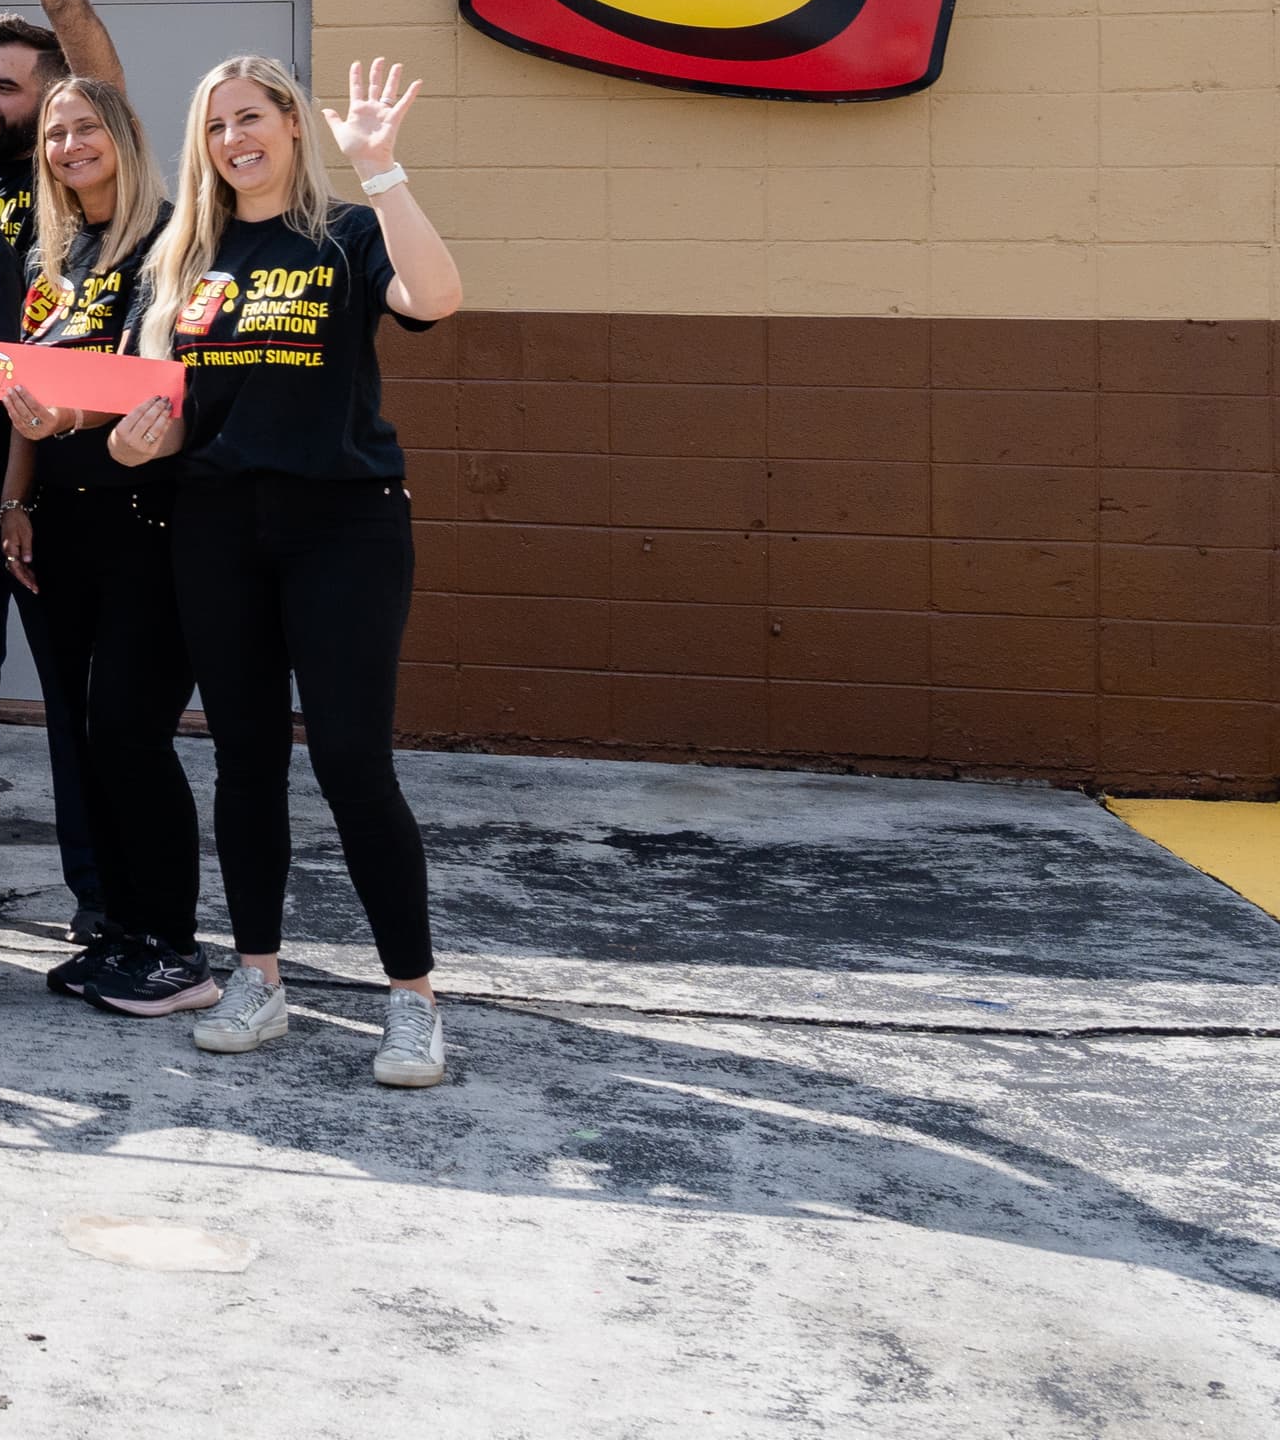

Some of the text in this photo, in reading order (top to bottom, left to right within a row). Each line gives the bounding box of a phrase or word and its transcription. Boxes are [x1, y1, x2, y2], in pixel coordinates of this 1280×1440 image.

[246, 265, 334, 300] 300TH
[25, 297, 53, 322] 5
[181, 296, 209, 321] 5
[238, 316, 317, 335] LOCATION
[265, 349, 324, 366] SIMPLE.
